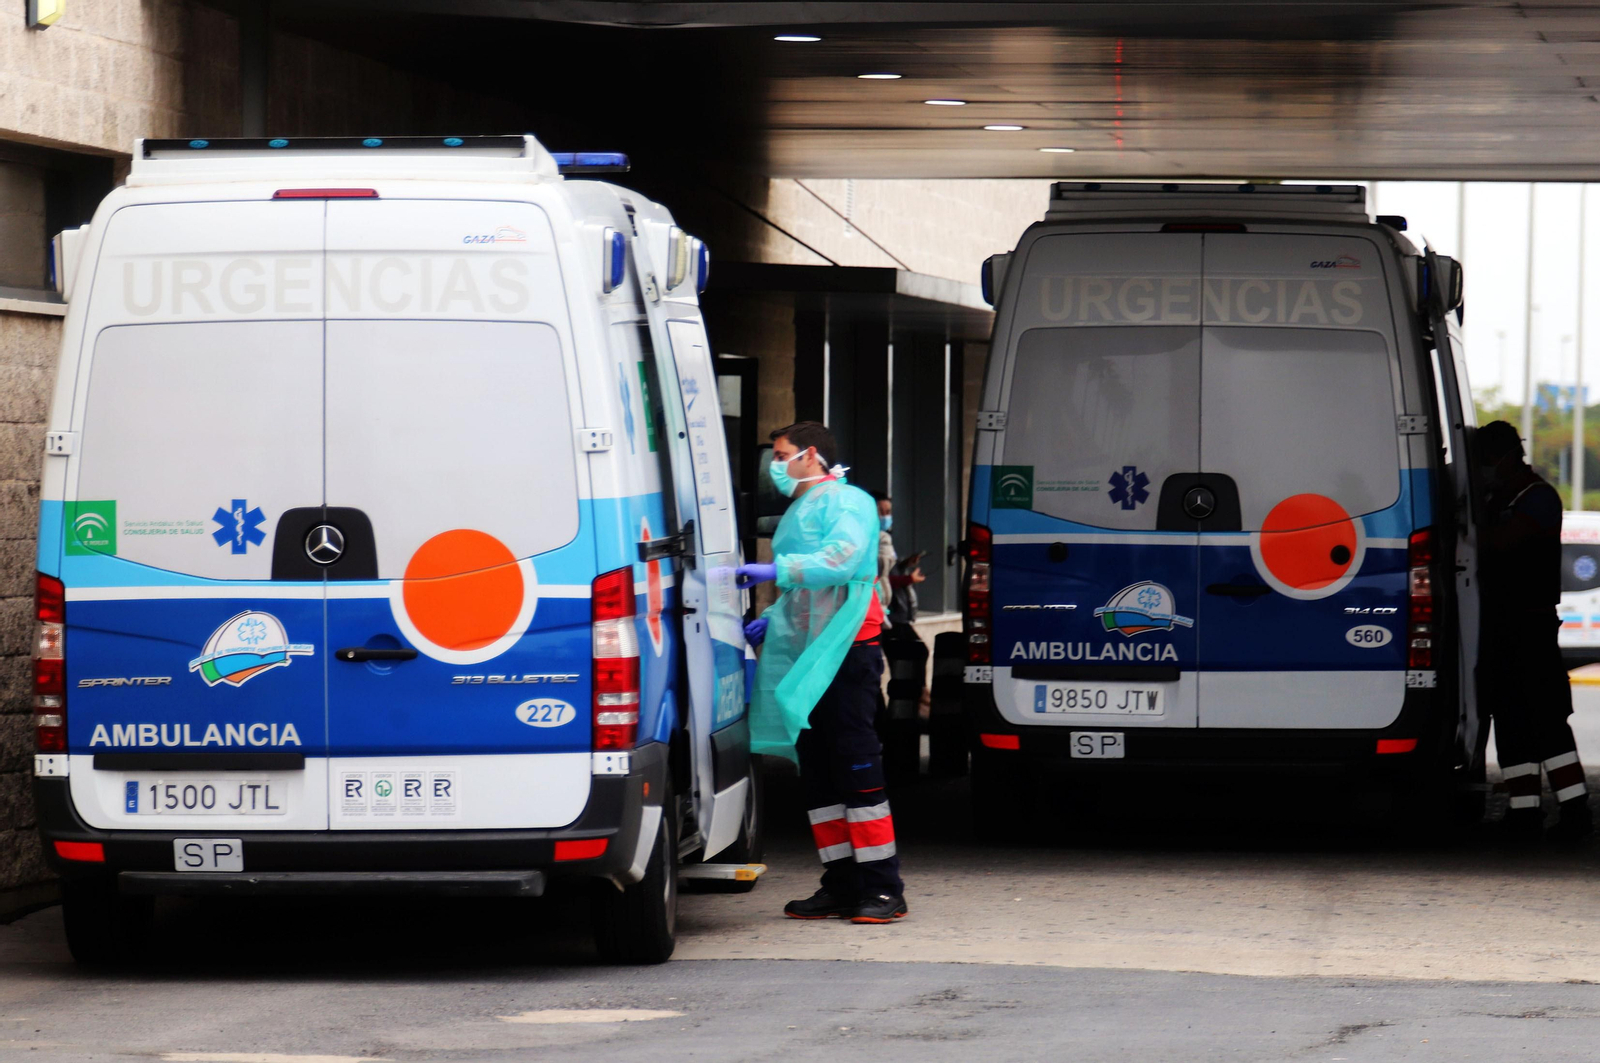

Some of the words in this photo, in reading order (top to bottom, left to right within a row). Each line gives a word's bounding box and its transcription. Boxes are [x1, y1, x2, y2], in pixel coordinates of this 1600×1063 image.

[463, 235, 495, 244] GAZA
[123, 256, 530, 317] URGENCIAS
[1039, 277, 1363, 325] URGENCIAS
[1354, 629, 1384, 643] 560
[1010, 641, 1179, 662] AMBULANCIA
[77, 676, 172, 688] SPRINTER
[451, 675, 485, 684] 313
[486, 674, 580, 684] BLUETEC
[1051, 688, 1107, 709] 9850
[1117, 690, 1158, 710] JTW
[526, 704, 566, 722] 227
[89, 723, 302, 747] AMBULANCIA
[150, 784, 216, 810] 1500
[228, 784, 280, 810] JTL
